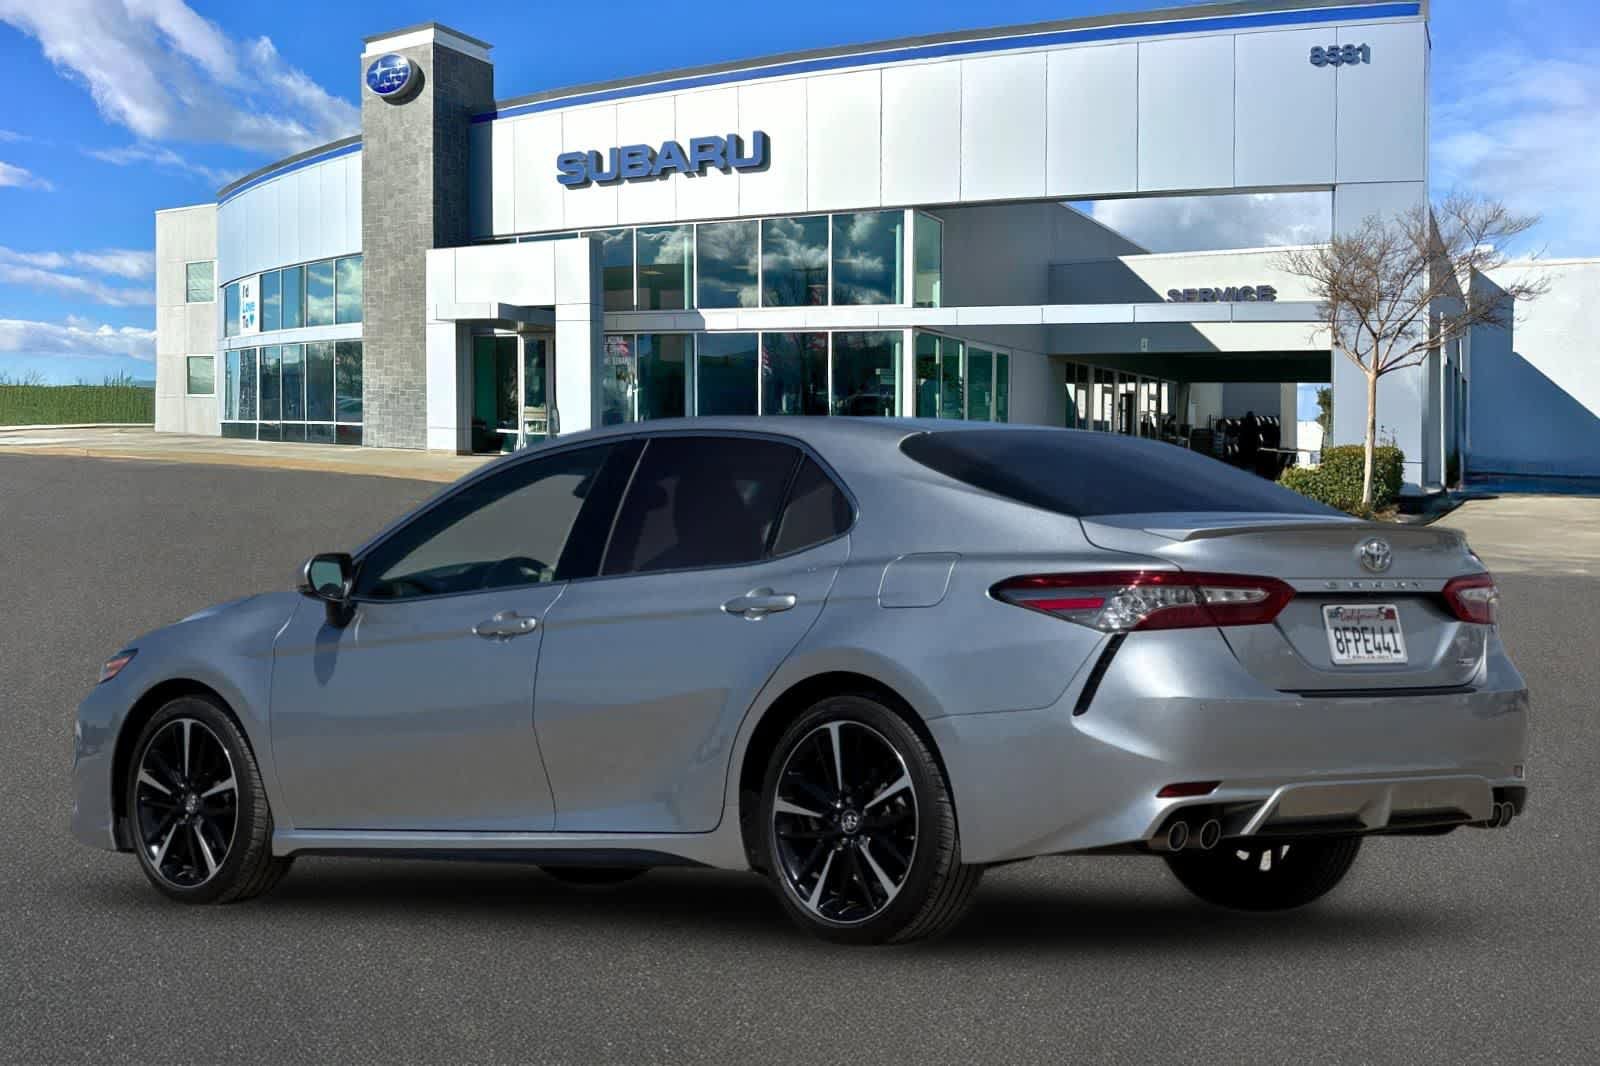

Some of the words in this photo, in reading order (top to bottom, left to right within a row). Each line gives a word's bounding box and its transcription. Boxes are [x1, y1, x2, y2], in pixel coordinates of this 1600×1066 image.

[557, 130, 769, 189] SUBARU
[1167, 285, 1277, 302] SERVICE
[1333, 626, 1401, 654] 8FPE441
